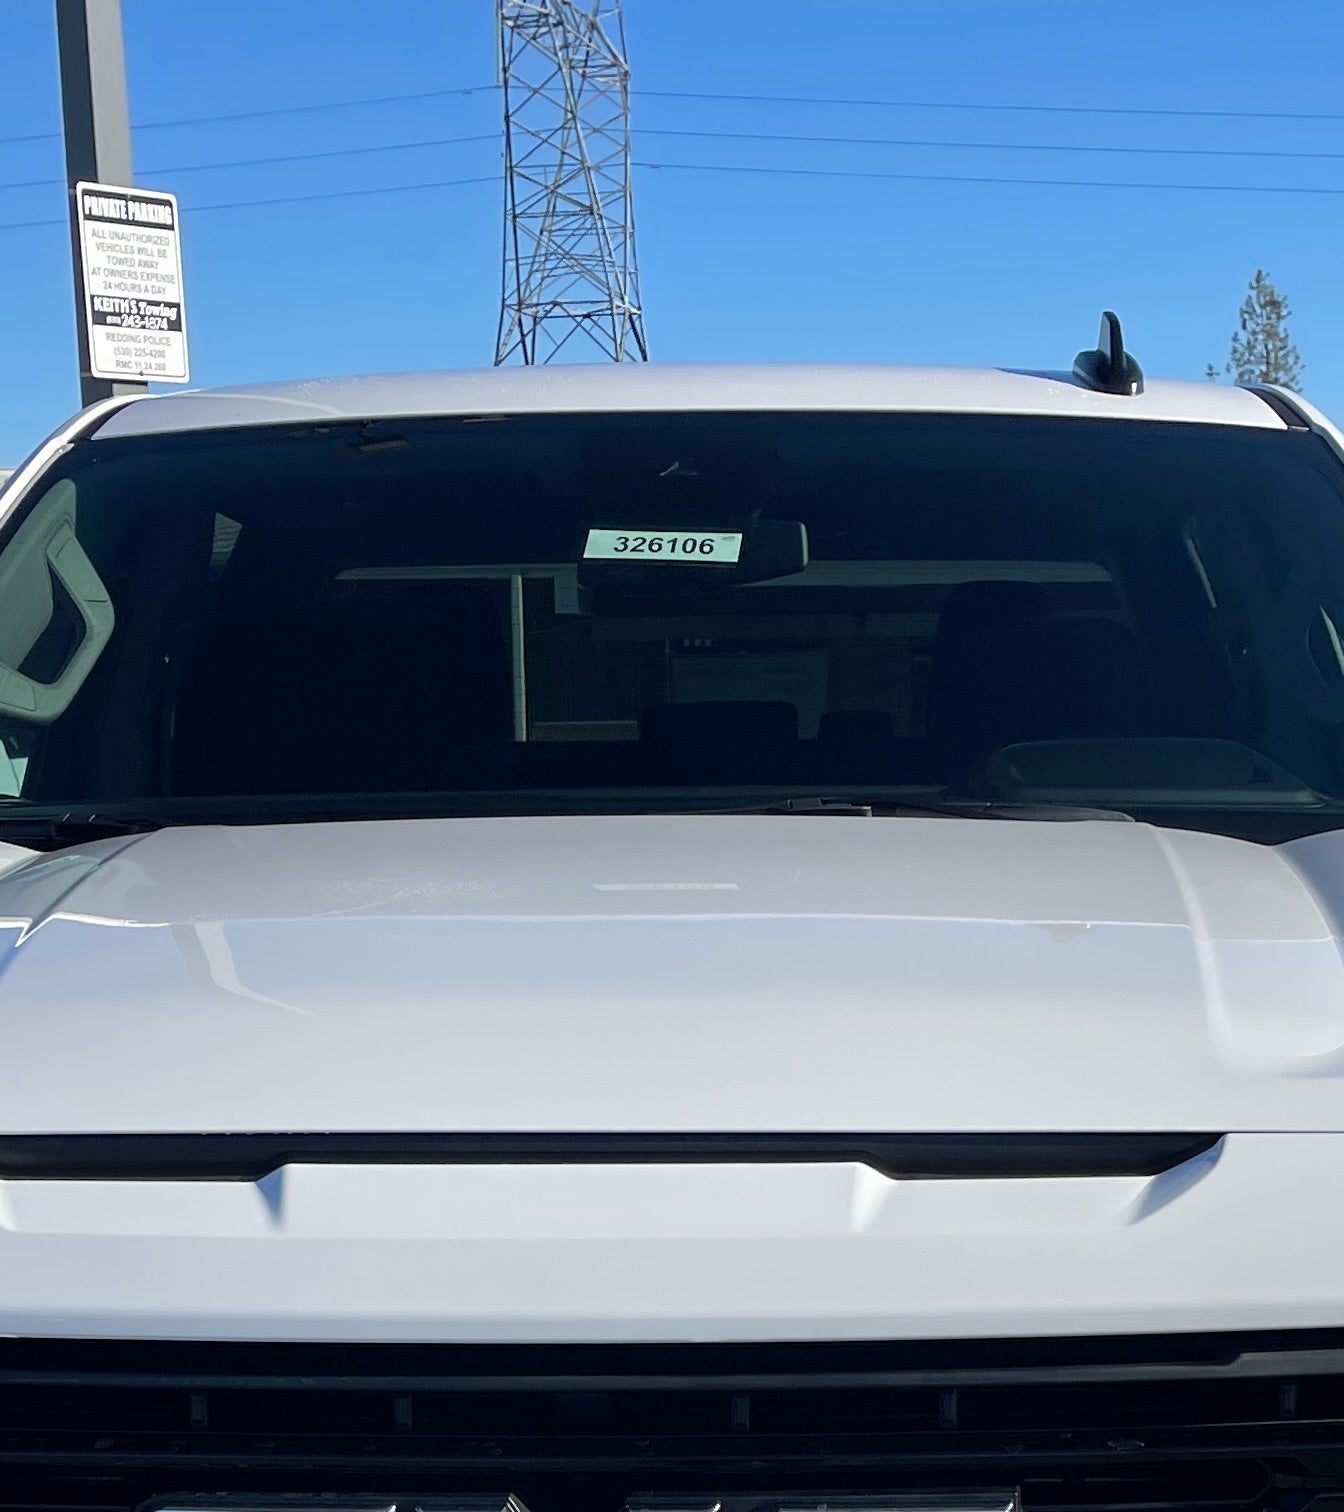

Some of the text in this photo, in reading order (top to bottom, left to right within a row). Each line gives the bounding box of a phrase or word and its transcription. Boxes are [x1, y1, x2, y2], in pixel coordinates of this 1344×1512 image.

[84, 195, 172, 225] PRIVATE PARKING
[92, 228, 170, 246] ALL UNAUTHORIZED
[96, 242, 167, 258] VEHICLES WILL BE
[107, 255, 158, 269] TOWED AWAY
[92, 267, 101, 275] AT
[141, 272, 176, 283] EXPENSE
[103, 281, 112, 290] 24
[114, 282, 141, 293] HOURS
[151, 285, 166, 295] DAY
[138, 301, 177, 320] Towing
[106, 332, 171, 346] REDDING POLICE
[613, 536, 715, 555] 326106
